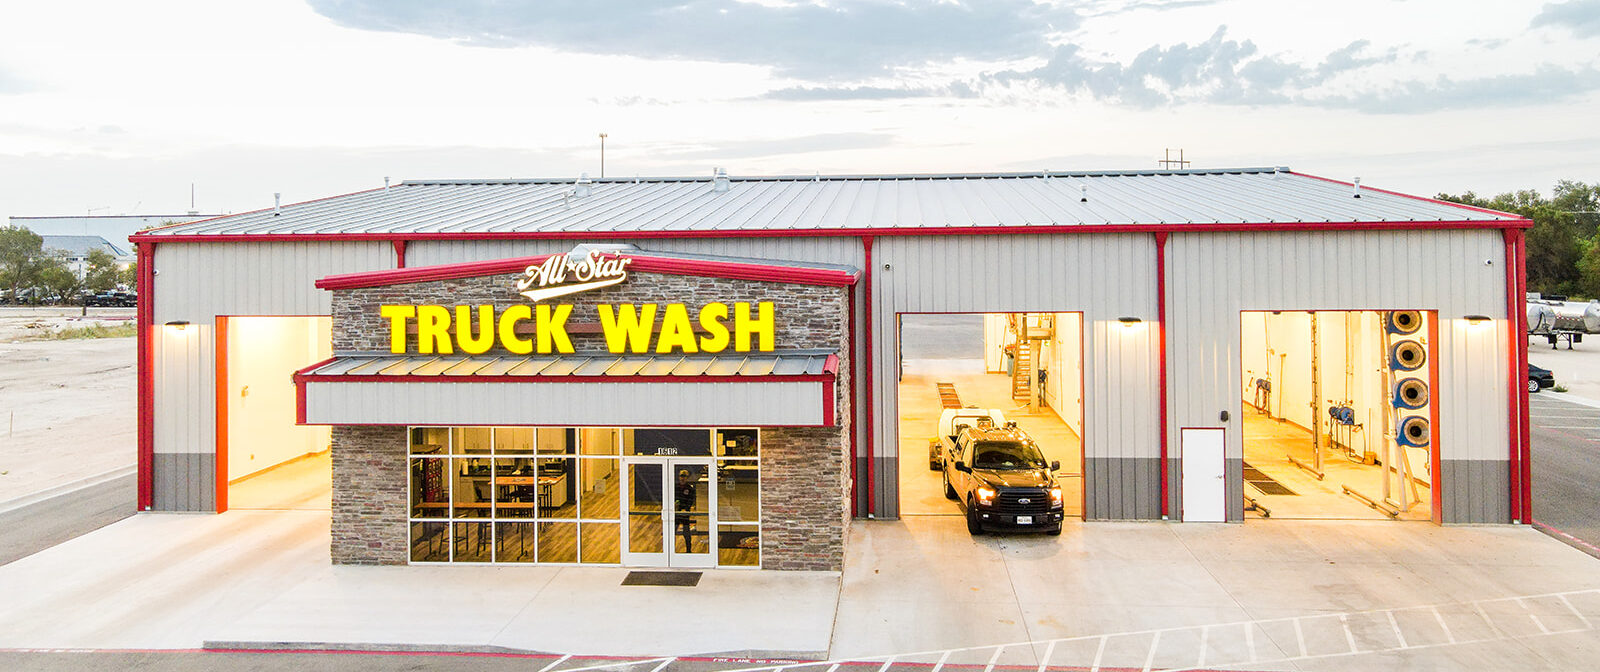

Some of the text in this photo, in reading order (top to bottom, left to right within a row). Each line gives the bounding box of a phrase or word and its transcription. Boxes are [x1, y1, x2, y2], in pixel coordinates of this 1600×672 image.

[517, 248, 632, 290] All Star
[381, 302, 775, 355] TRUCK WASH
